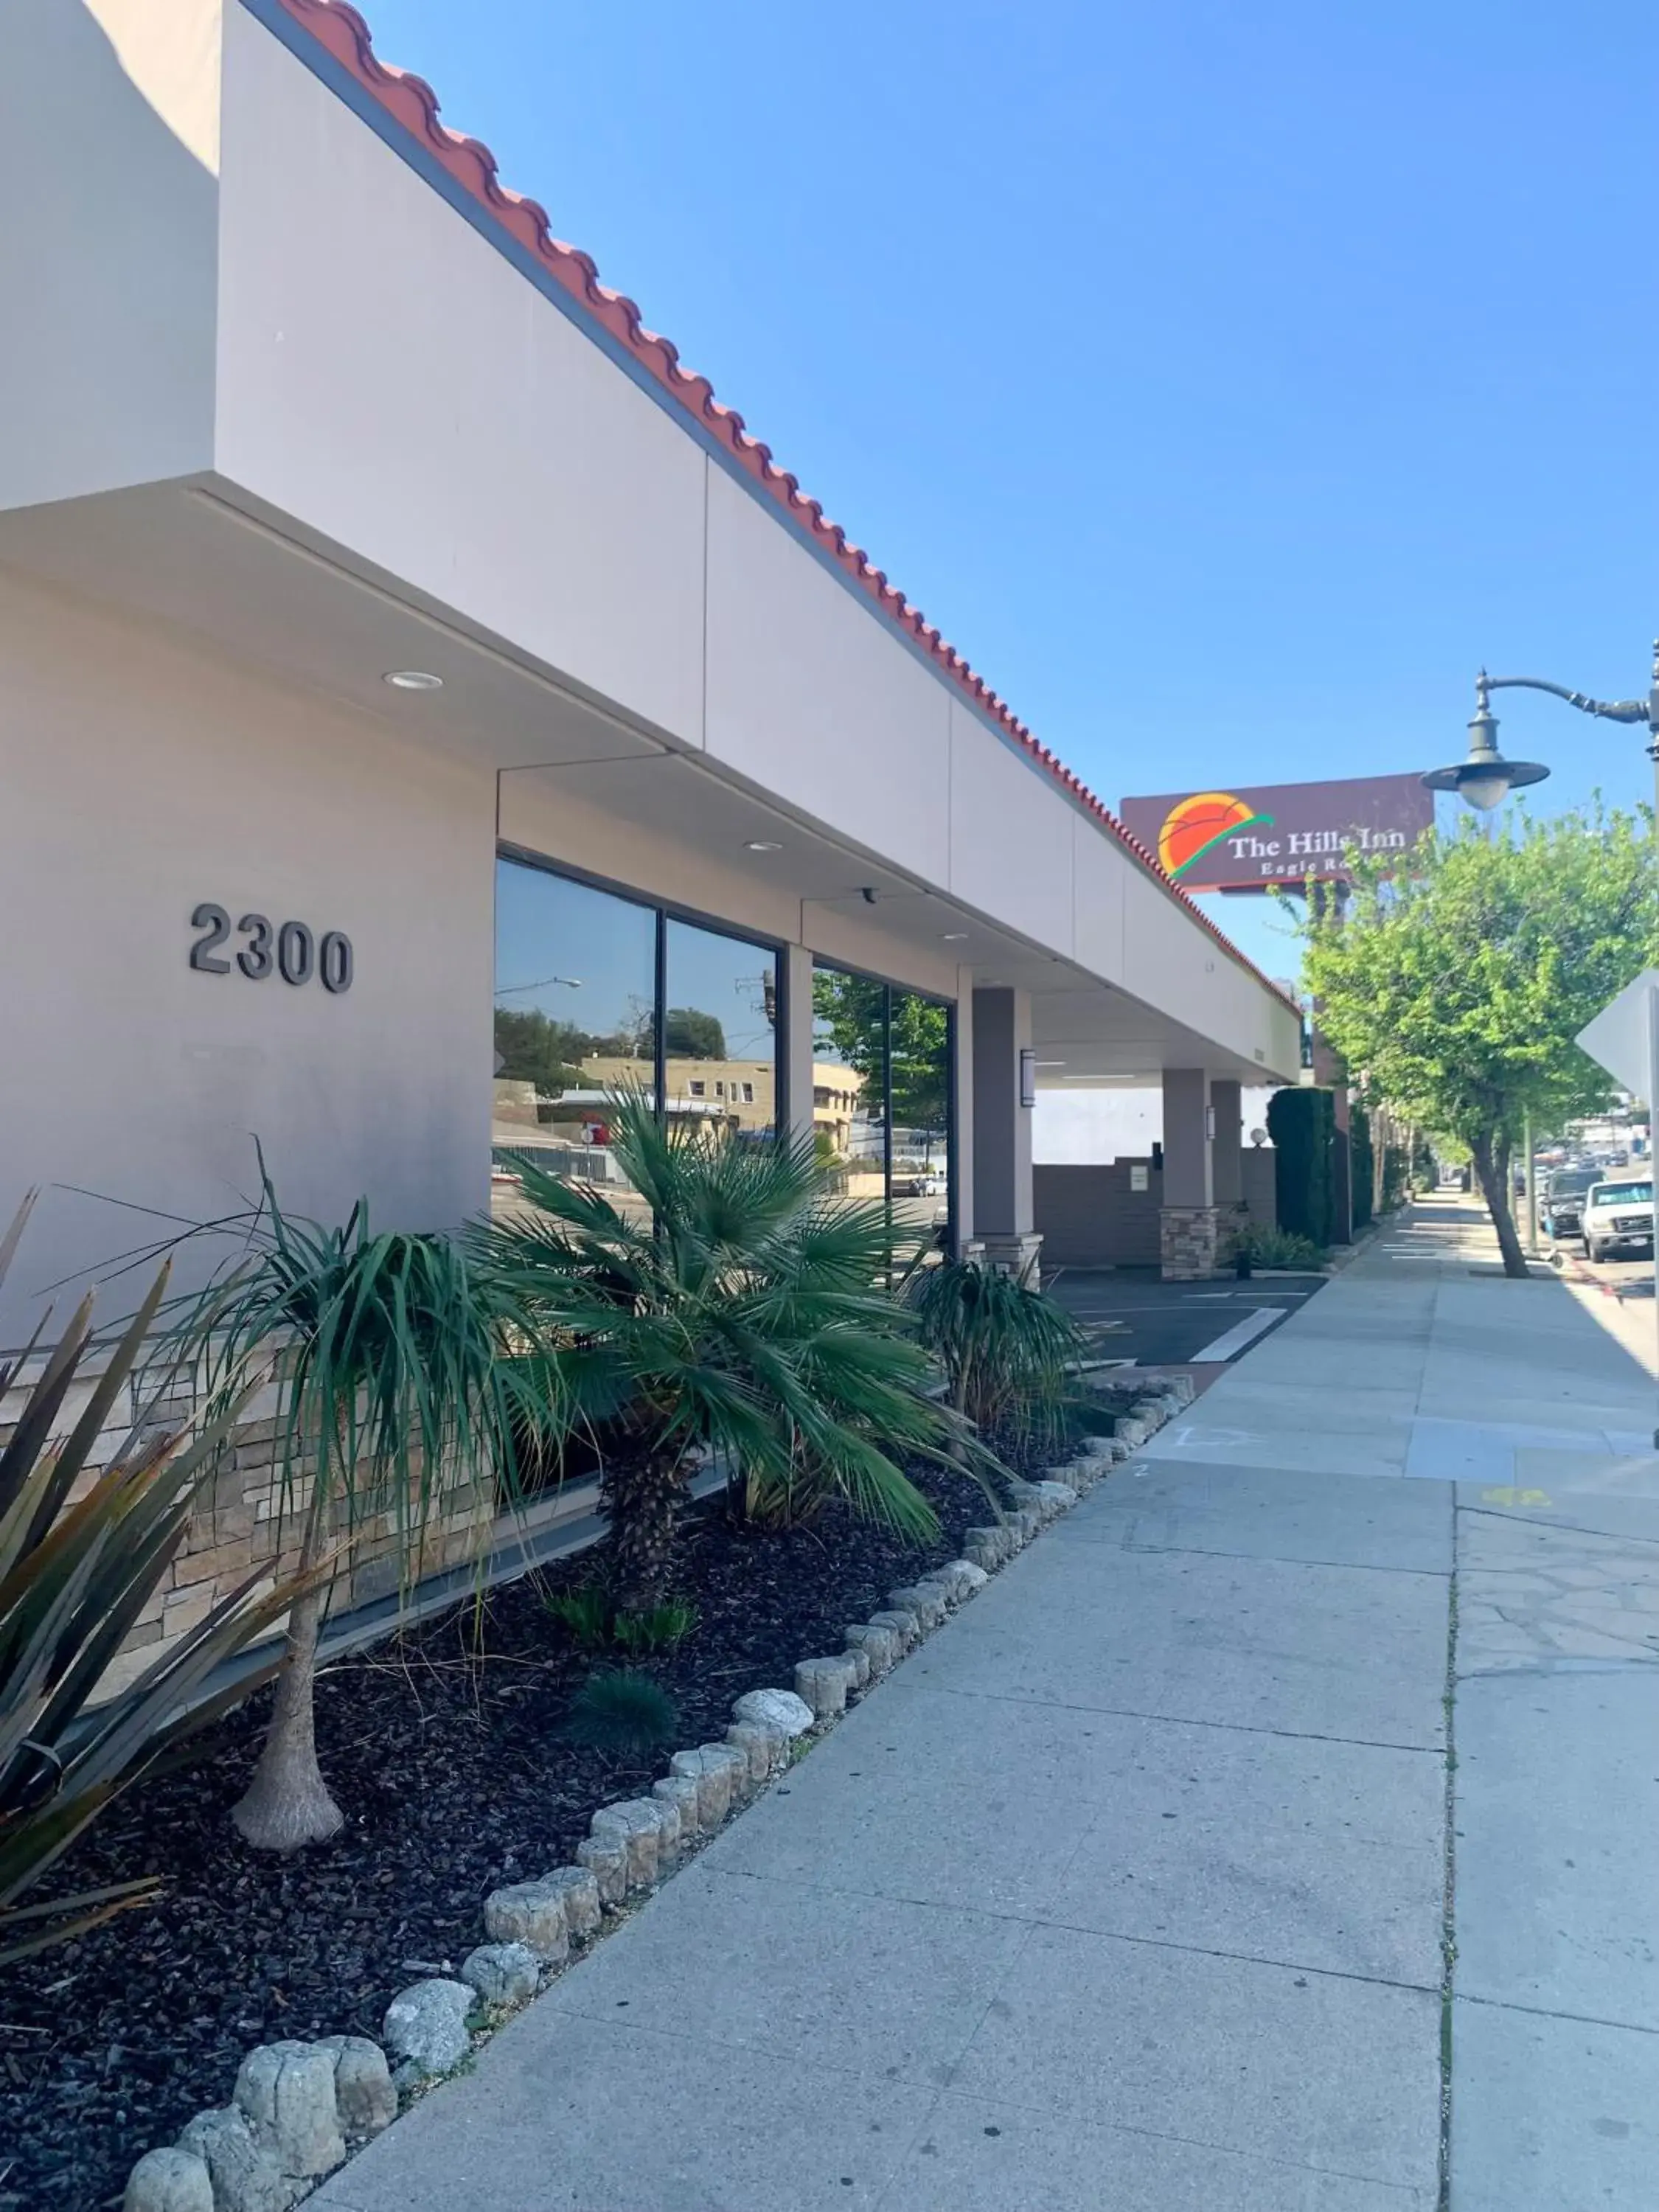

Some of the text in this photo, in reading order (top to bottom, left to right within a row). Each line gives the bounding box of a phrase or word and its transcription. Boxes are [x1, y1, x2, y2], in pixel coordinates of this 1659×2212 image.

[1228, 827, 1405, 859] The Hills Inn
[1261, 860, 1316, 876] Eagle
[189, 903, 353, 994] 2300
